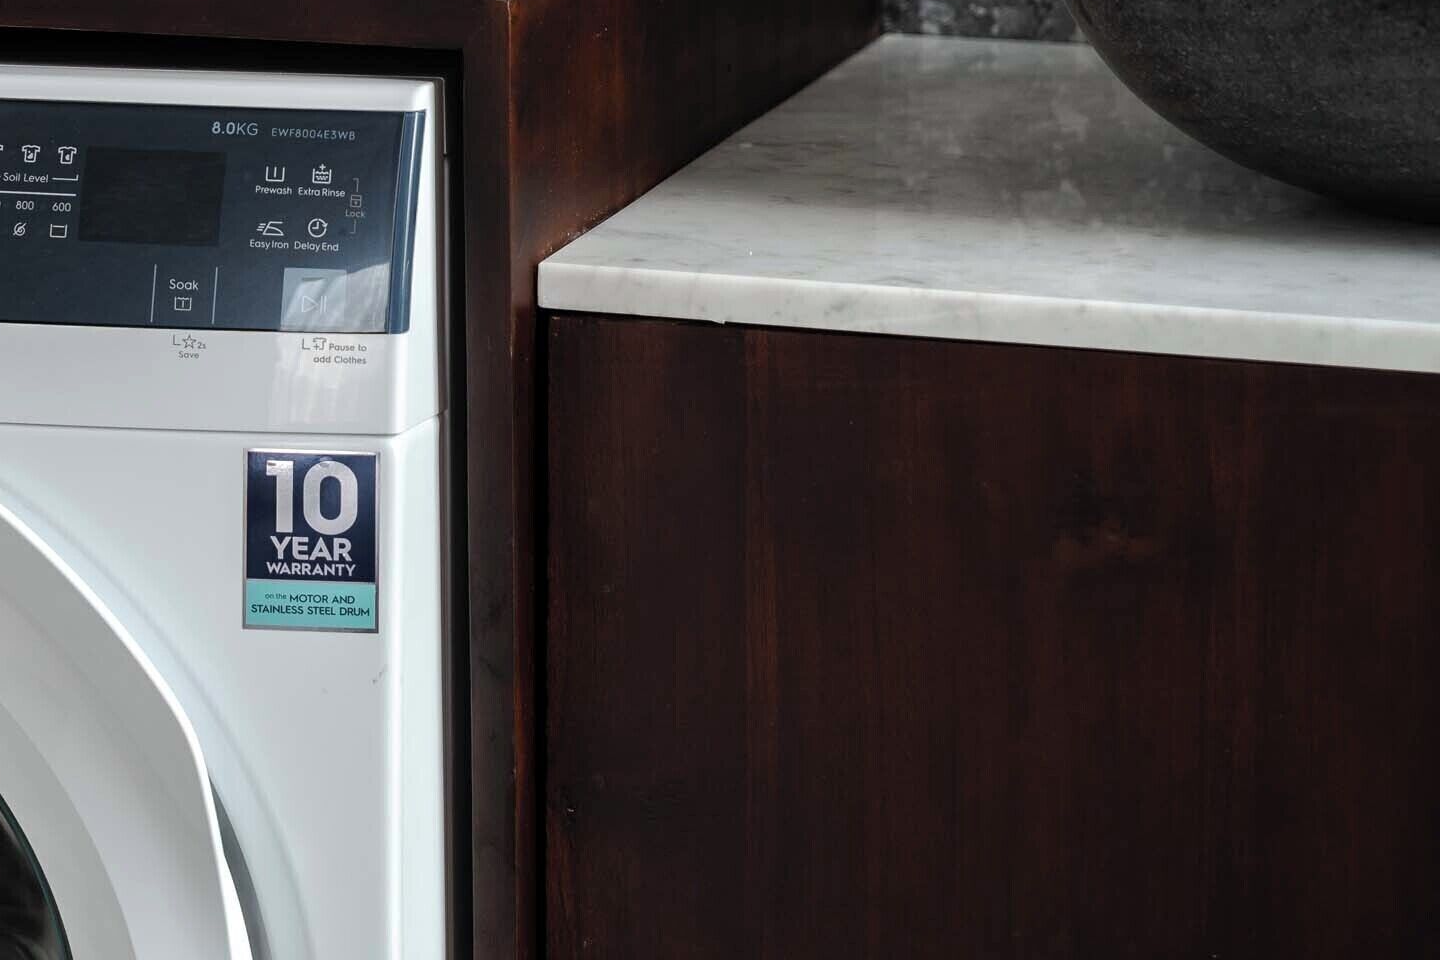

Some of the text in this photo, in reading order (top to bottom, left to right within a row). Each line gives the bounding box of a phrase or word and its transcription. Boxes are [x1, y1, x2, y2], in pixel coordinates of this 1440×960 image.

[211, 121, 259, 136] 8.0KG
[2, 171, 49, 184] Soil Level
[255, 185, 293, 196] Prewash
[297, 186, 346, 199] Extra Rinse
[15, 200, 35, 211] 800
[52, 201, 72, 213] 600
[345, 208, 366, 218] Lock
[249, 239, 290, 251] Easy Iron
[293, 240, 339, 252] Delay End
[169, 278, 199, 291] Soak
[328, 343, 368, 353] Pause to
[178, 350, 200, 360] Save
[313, 354, 367, 366] add Clothes
[266, 460, 359, 536] 10
[270, 535, 353, 562] YEAR
[266, 561, 357, 577] WARRANTY
[289, 593, 329, 604] MOTOR
[331, 594, 356, 605] AND
[251, 603, 371, 618] STAINLESS STEEL DRUM
